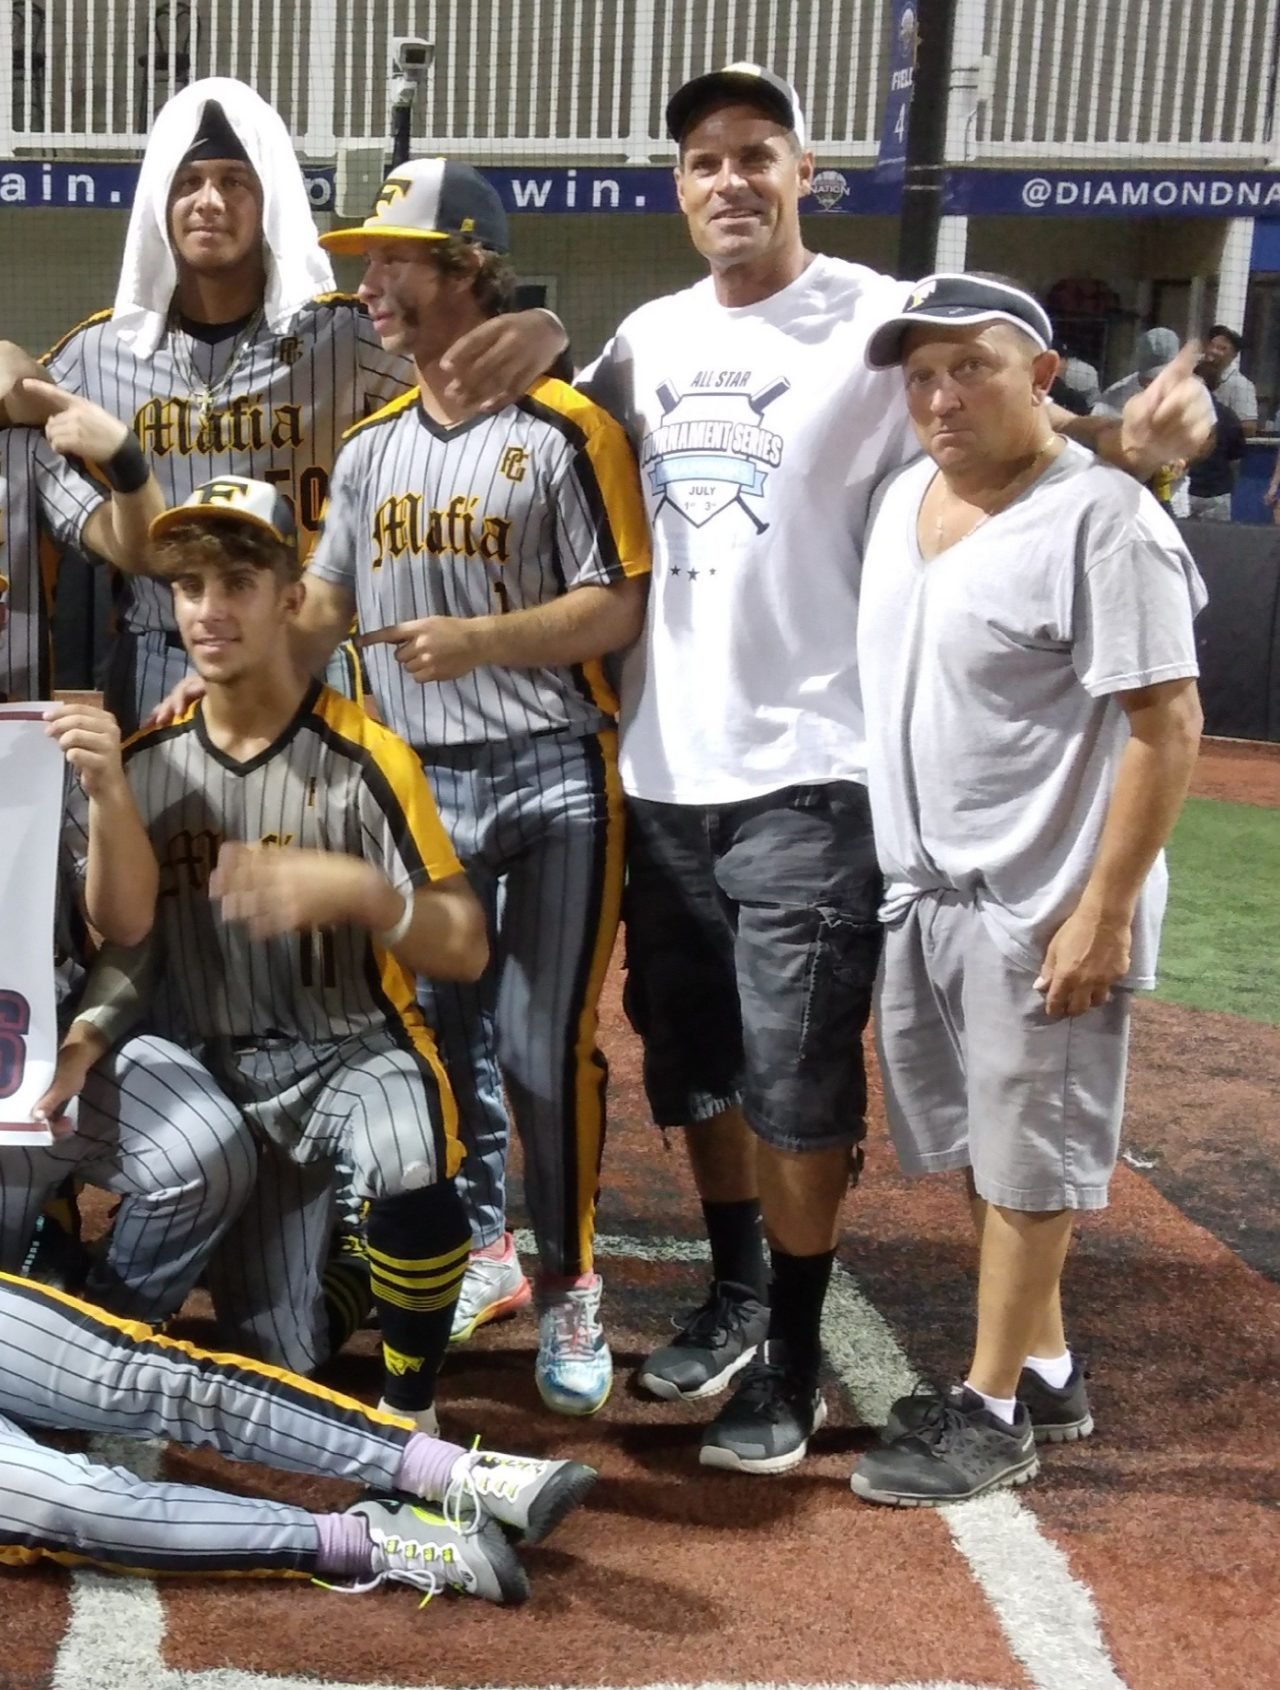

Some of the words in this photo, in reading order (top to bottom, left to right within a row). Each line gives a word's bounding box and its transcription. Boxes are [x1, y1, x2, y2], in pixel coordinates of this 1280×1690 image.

[891, 66, 914, 91] FIEL
[894, 103, 906, 143] 4
[511, 169, 646, 208] win.
[690, 371, 713, 388] ALL
[714, 371, 752, 388] STAR
[133, 394, 306, 457] Mafia
[732, 422, 784, 469] SERIES
[688, 486, 717, 496] JULY
[372, 492, 513, 569] Mafia
